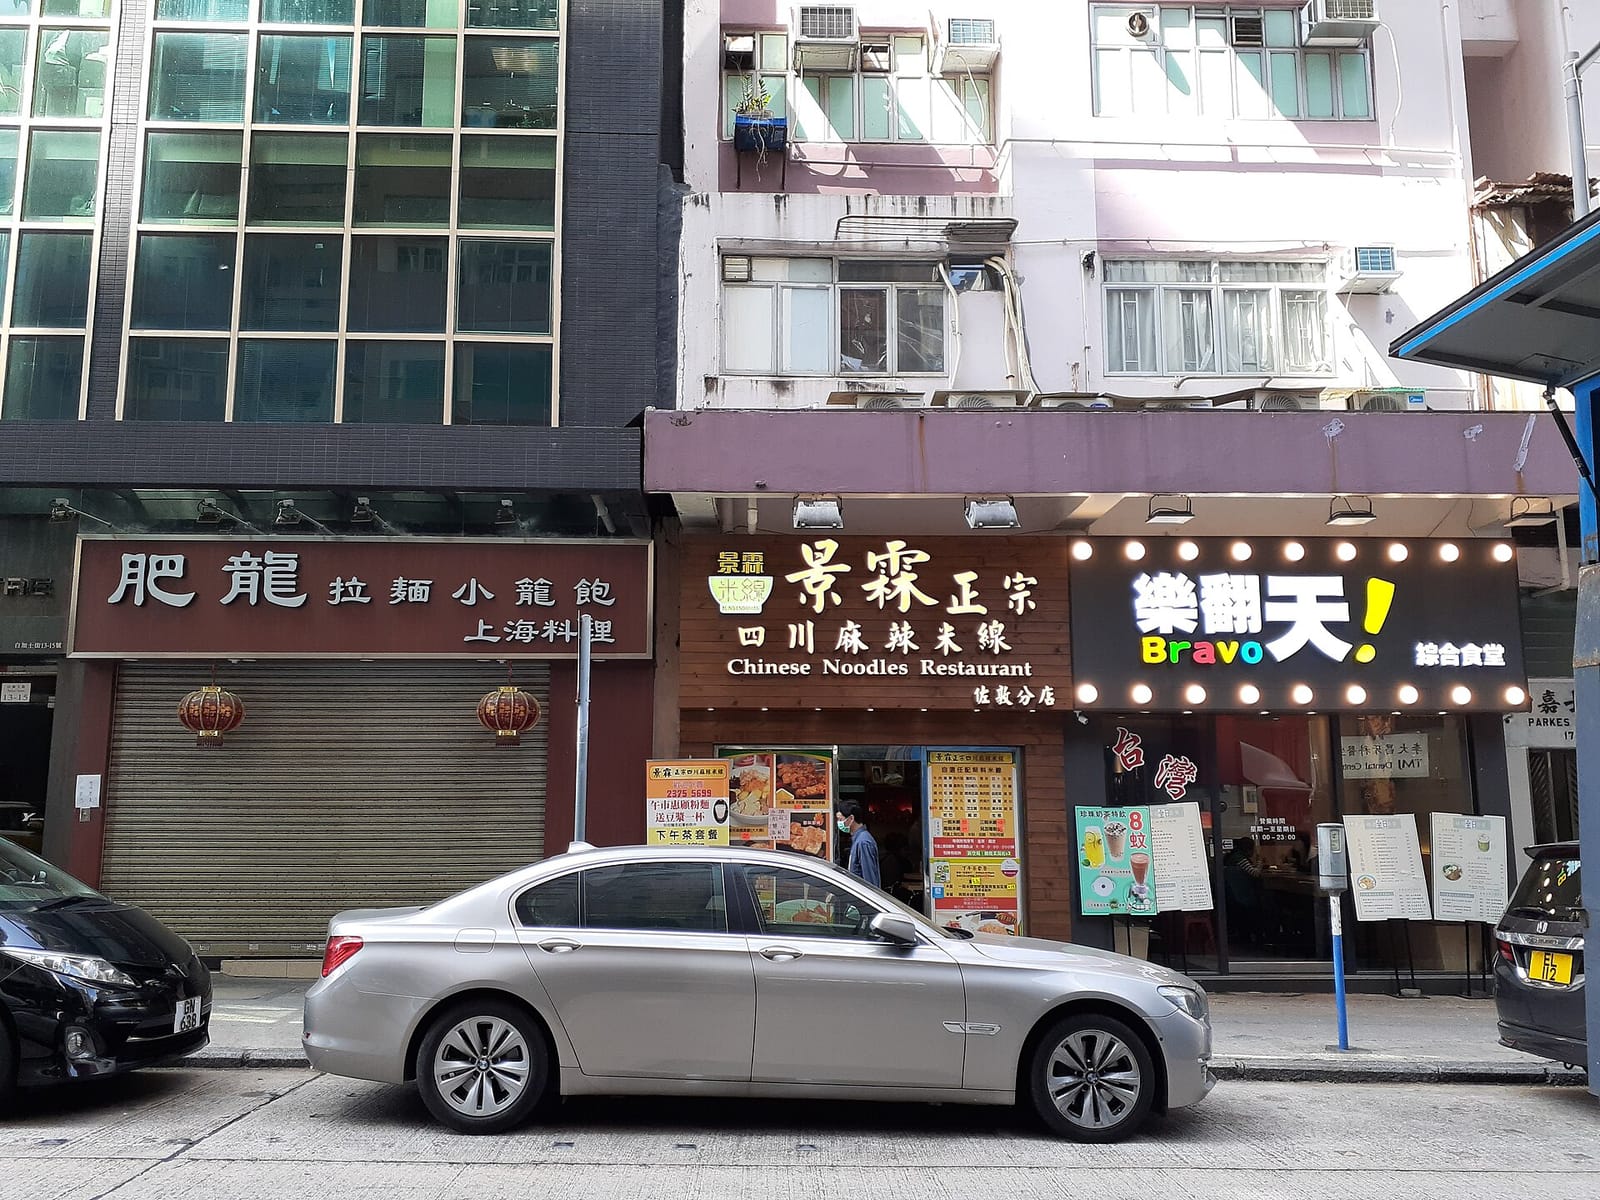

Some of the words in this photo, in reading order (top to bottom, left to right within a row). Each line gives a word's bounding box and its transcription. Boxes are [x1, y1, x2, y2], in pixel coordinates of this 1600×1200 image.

[717, 551, 764, 574] 景霖
[718, 578, 765, 602] 米線
[464, 618, 615, 643] 上海料理
[738, 620, 1012, 656] 四川麻辣米線
[1142, 636, 1264, 664] Bravo
[1415, 642, 1506, 668] 綜合食堂
[727, 658, 811, 676] Chinese
[823, 658, 908, 676] Noodles
[920, 658, 1032, 677] Restaurant
[973, 685, 1056, 706] 佐敦分店
[1528, 718, 1570, 727] PARKES
[666, 789, 687, 798] 2375
[691, 789, 712, 798] 5699
[656, 829, 719, 841] 下午茶套餐
[1544, 952, 1557, 967] EL
[1542, 966, 1557, 981] 112
